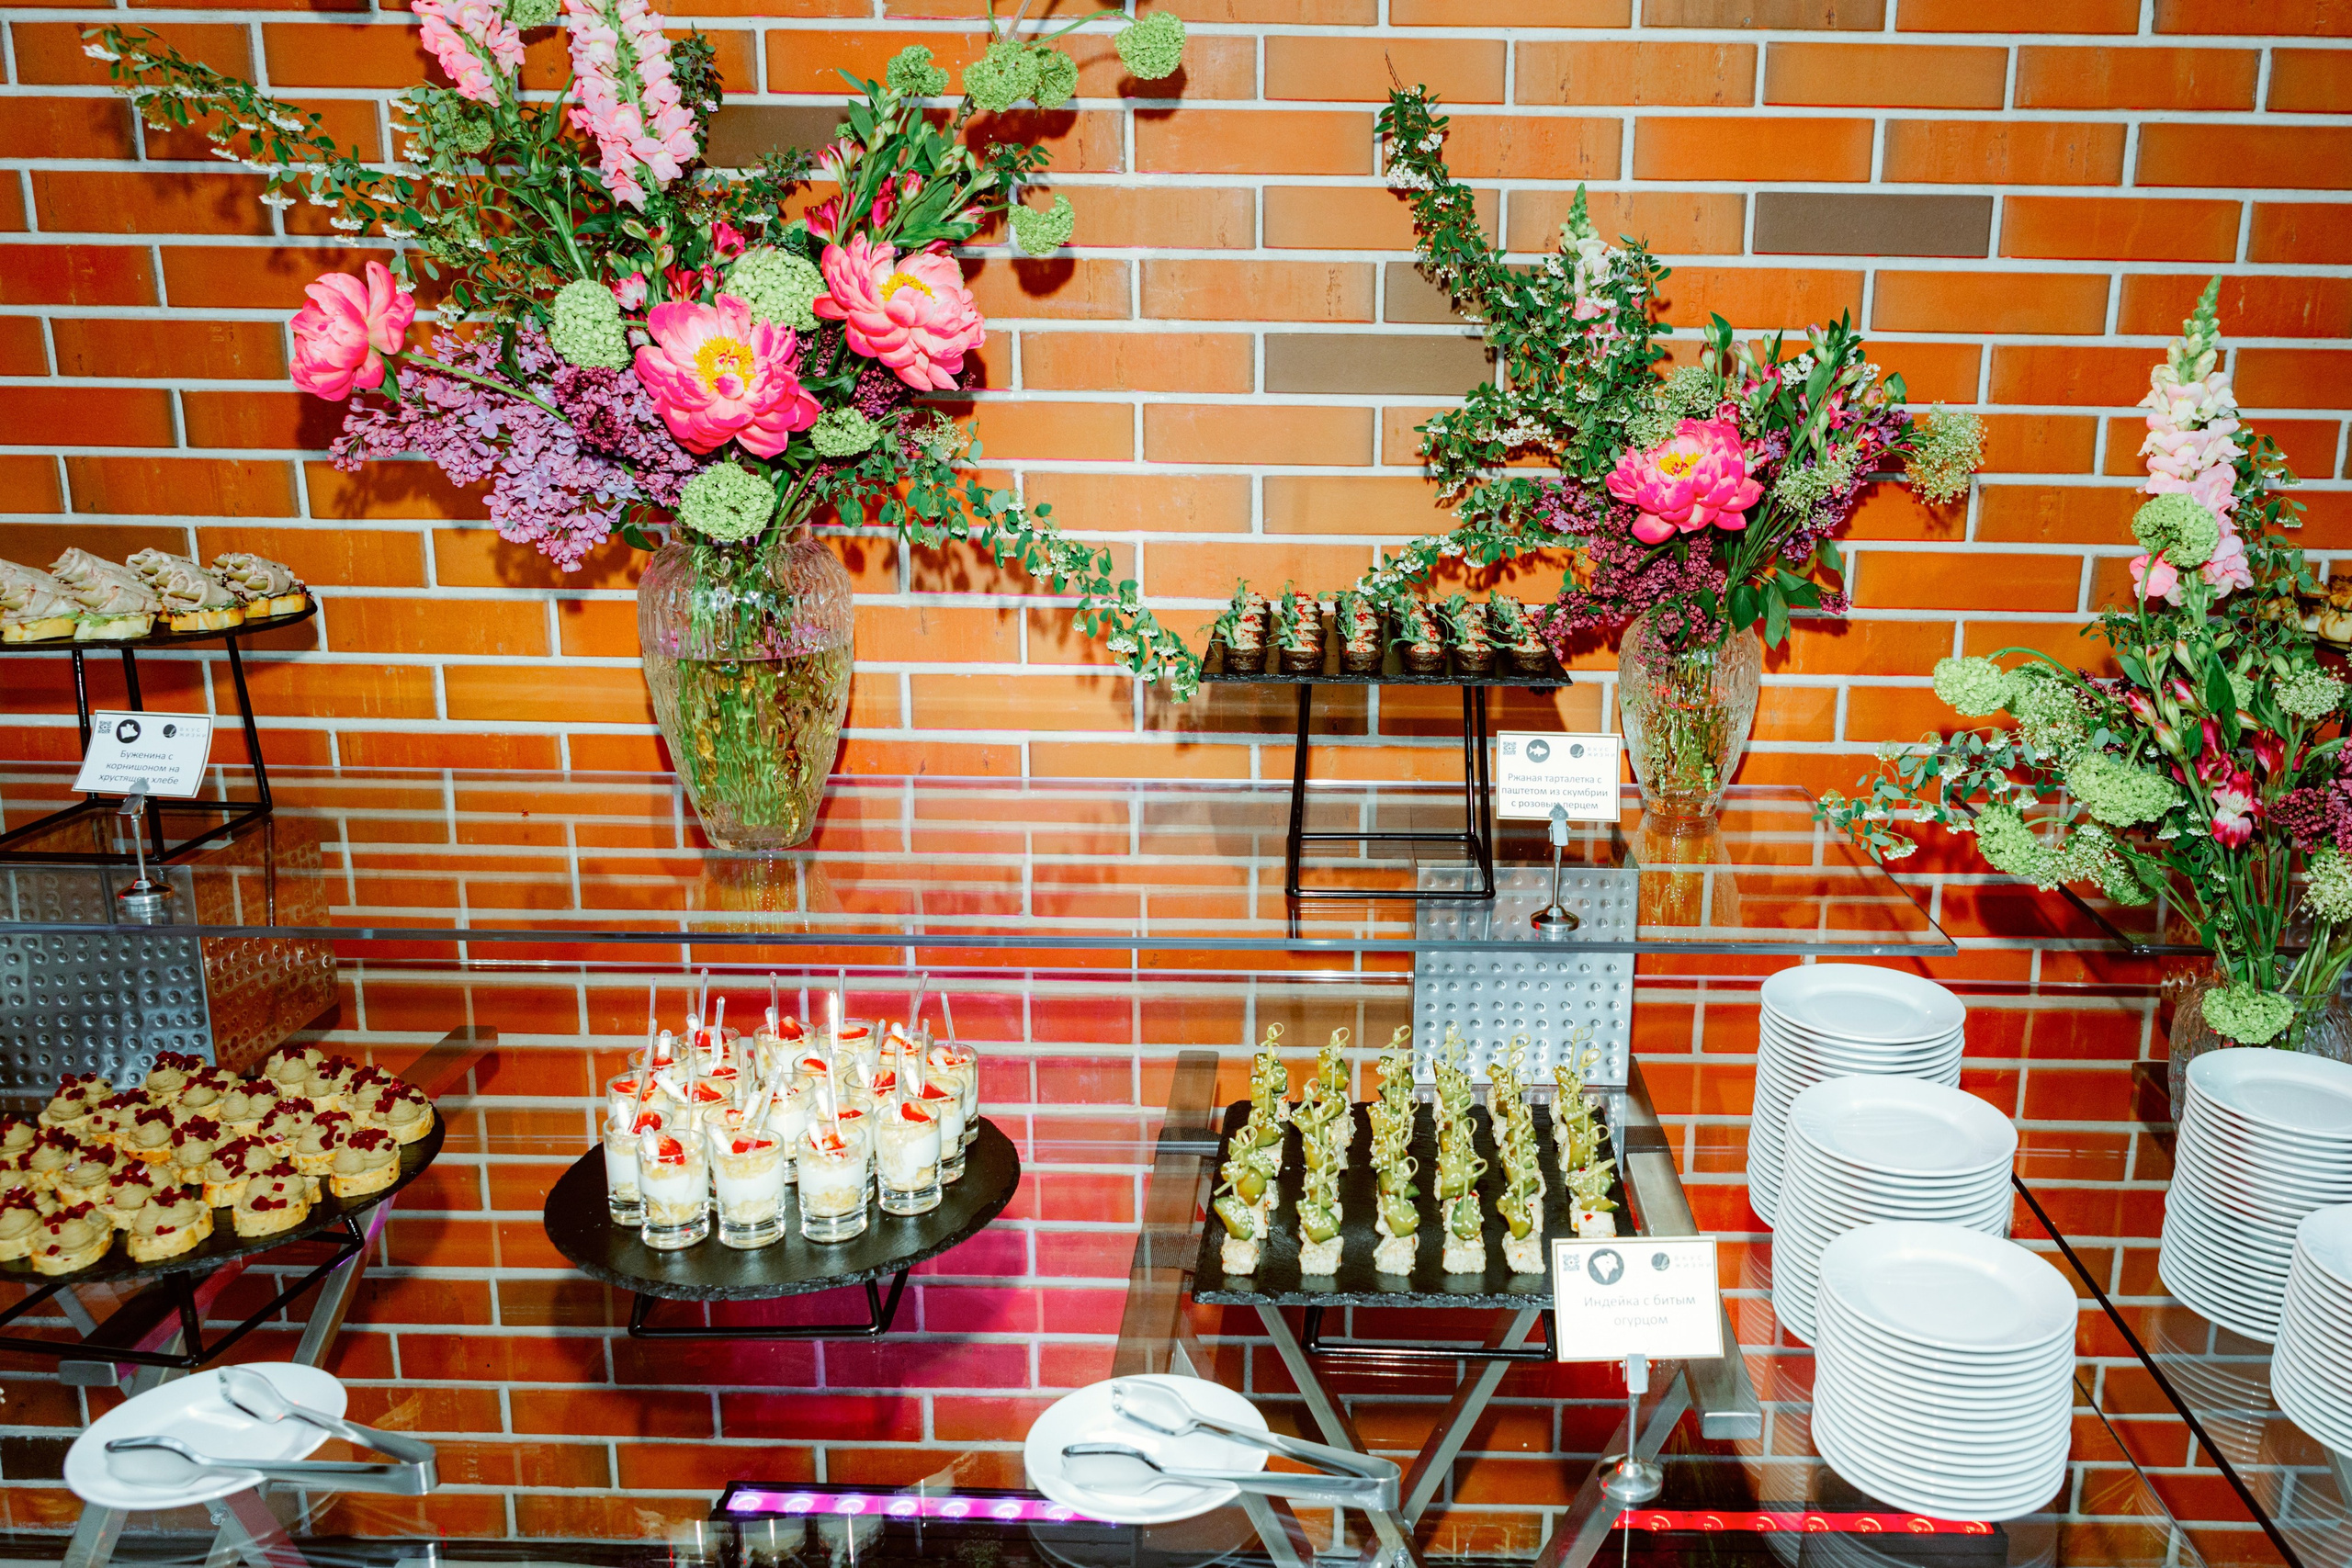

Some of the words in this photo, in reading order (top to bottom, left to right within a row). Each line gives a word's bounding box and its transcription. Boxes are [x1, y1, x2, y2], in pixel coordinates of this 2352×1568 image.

[119, 750, 167, 761] Буженина
[106, 762, 167, 773] корнишоном
[98, 773, 150, 784] хрустяще
[151, 776, 179, 784] хлебе
[1508, 773, 1543, 783] Ржаная
[1544, 775, 1595, 784] тарталетка
[1501, 787, 1547, 795] паштетом
[1562, 787, 1608, 797] скумбрии
[1563, 802, 1599, 810] перцем
[1584, 1295, 1640, 1308] Индейка
[1653, 1294, 1696, 1305] битым
[1613, 1315, 1668, 1327] огурцом
